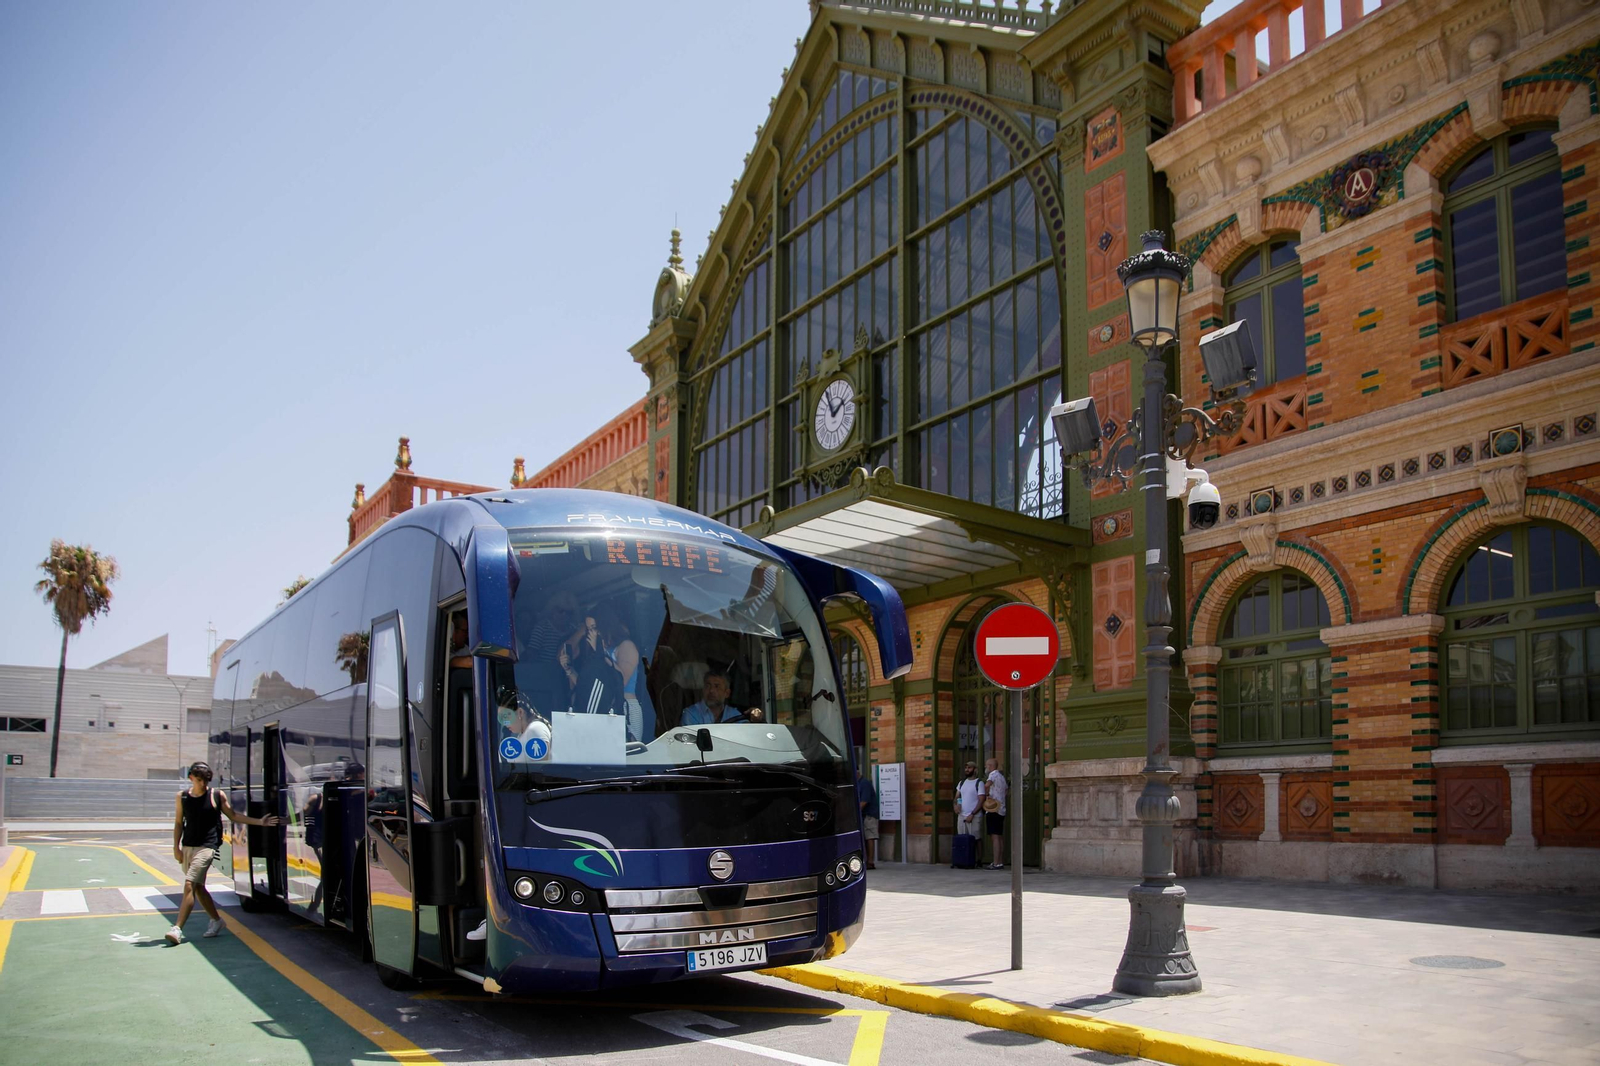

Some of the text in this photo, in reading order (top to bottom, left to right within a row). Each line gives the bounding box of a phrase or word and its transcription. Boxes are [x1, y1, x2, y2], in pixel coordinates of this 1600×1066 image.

[1350, 172, 1368, 197] A
[567, 514, 737, 542] FRAHERMAR
[606, 538, 723, 573] RENFE
[803, 811, 818, 821] SC7
[699, 928, 755, 944] MAN
[699, 947, 763, 967] 5196 JZV
